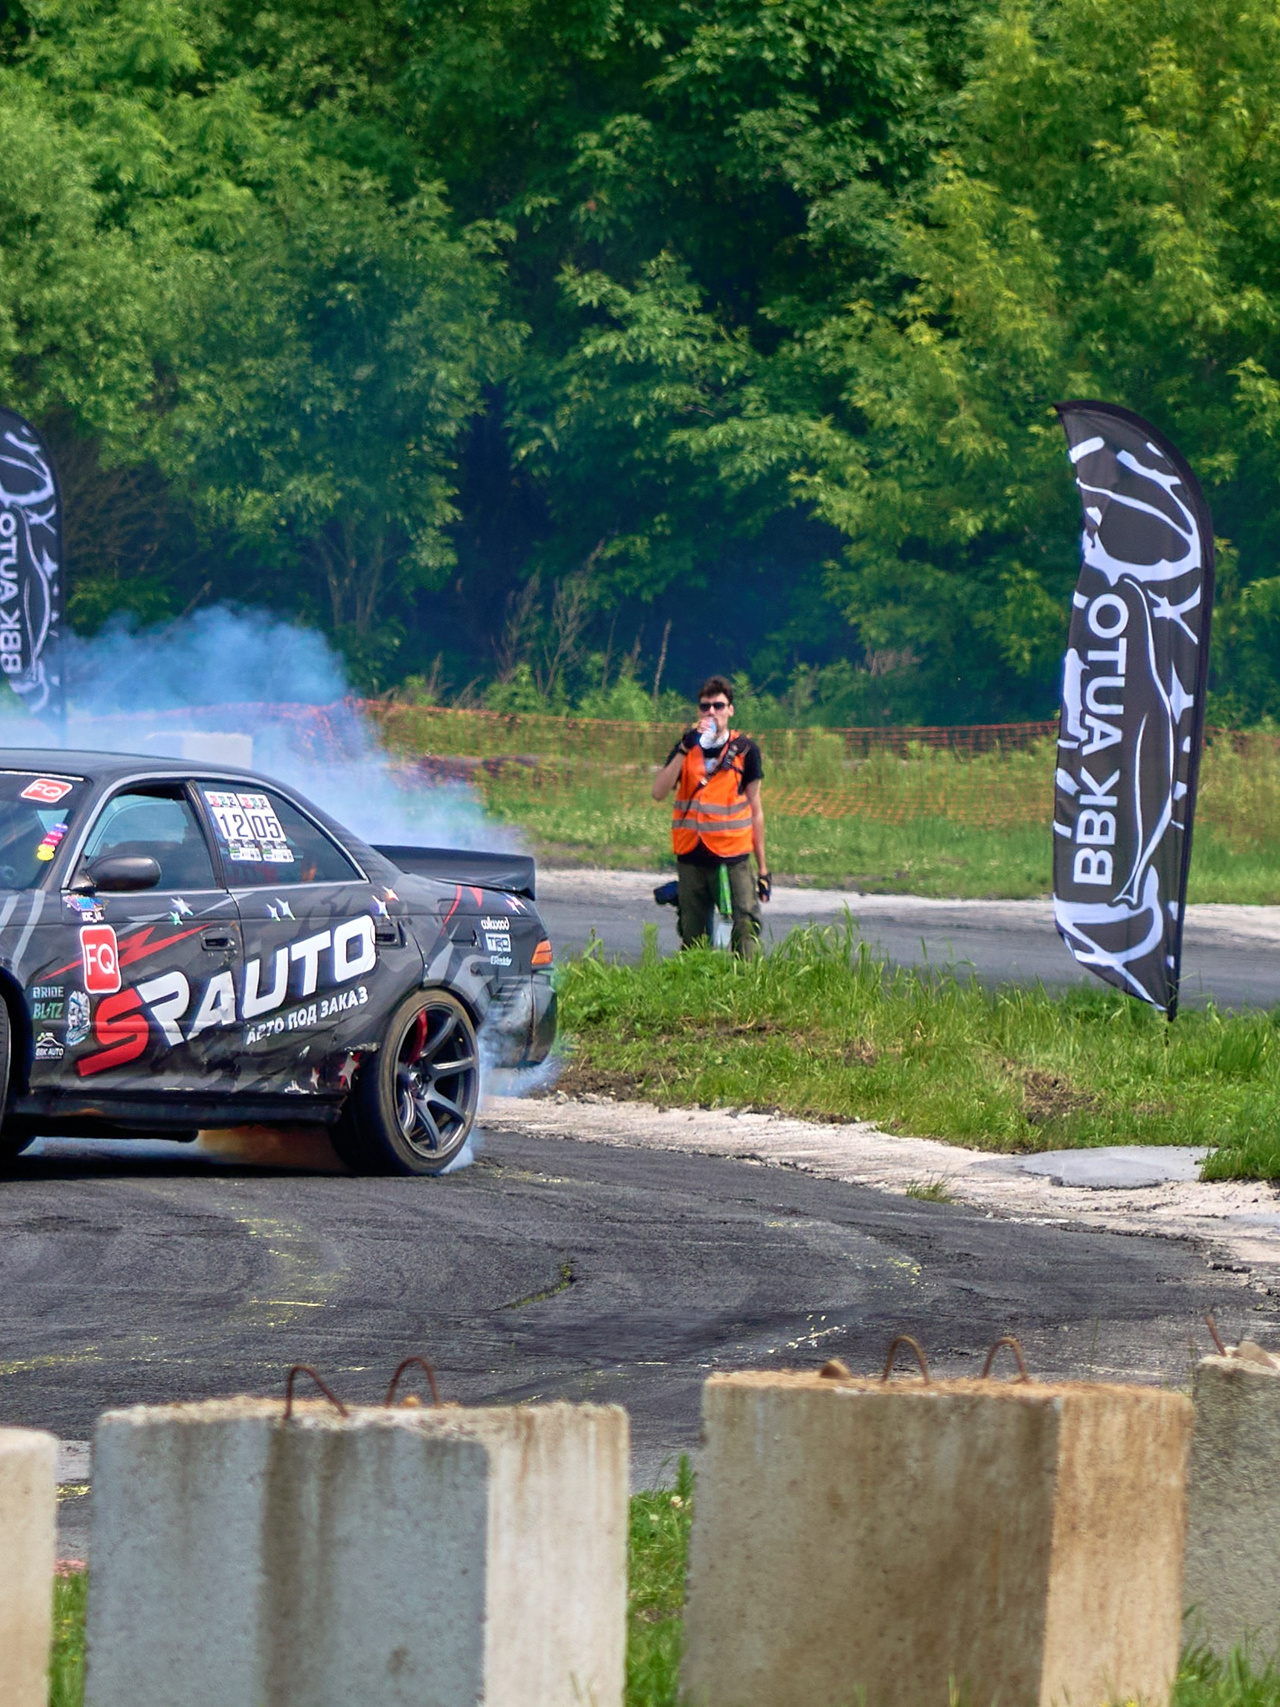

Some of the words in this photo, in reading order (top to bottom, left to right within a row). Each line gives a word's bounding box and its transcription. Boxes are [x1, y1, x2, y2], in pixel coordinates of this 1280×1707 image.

[28, 783, 63, 797] FQ
[220, 813, 249, 838] 12
[251, 815, 281, 839] 05
[85, 943, 116, 976] FQ
[32, 986, 65, 999] BRIDE
[32, 1002, 64, 1019] BLITZ
[288, 1004, 318, 1030] ПОД
[320, 986, 369, 1019] ЗАКАЗ
